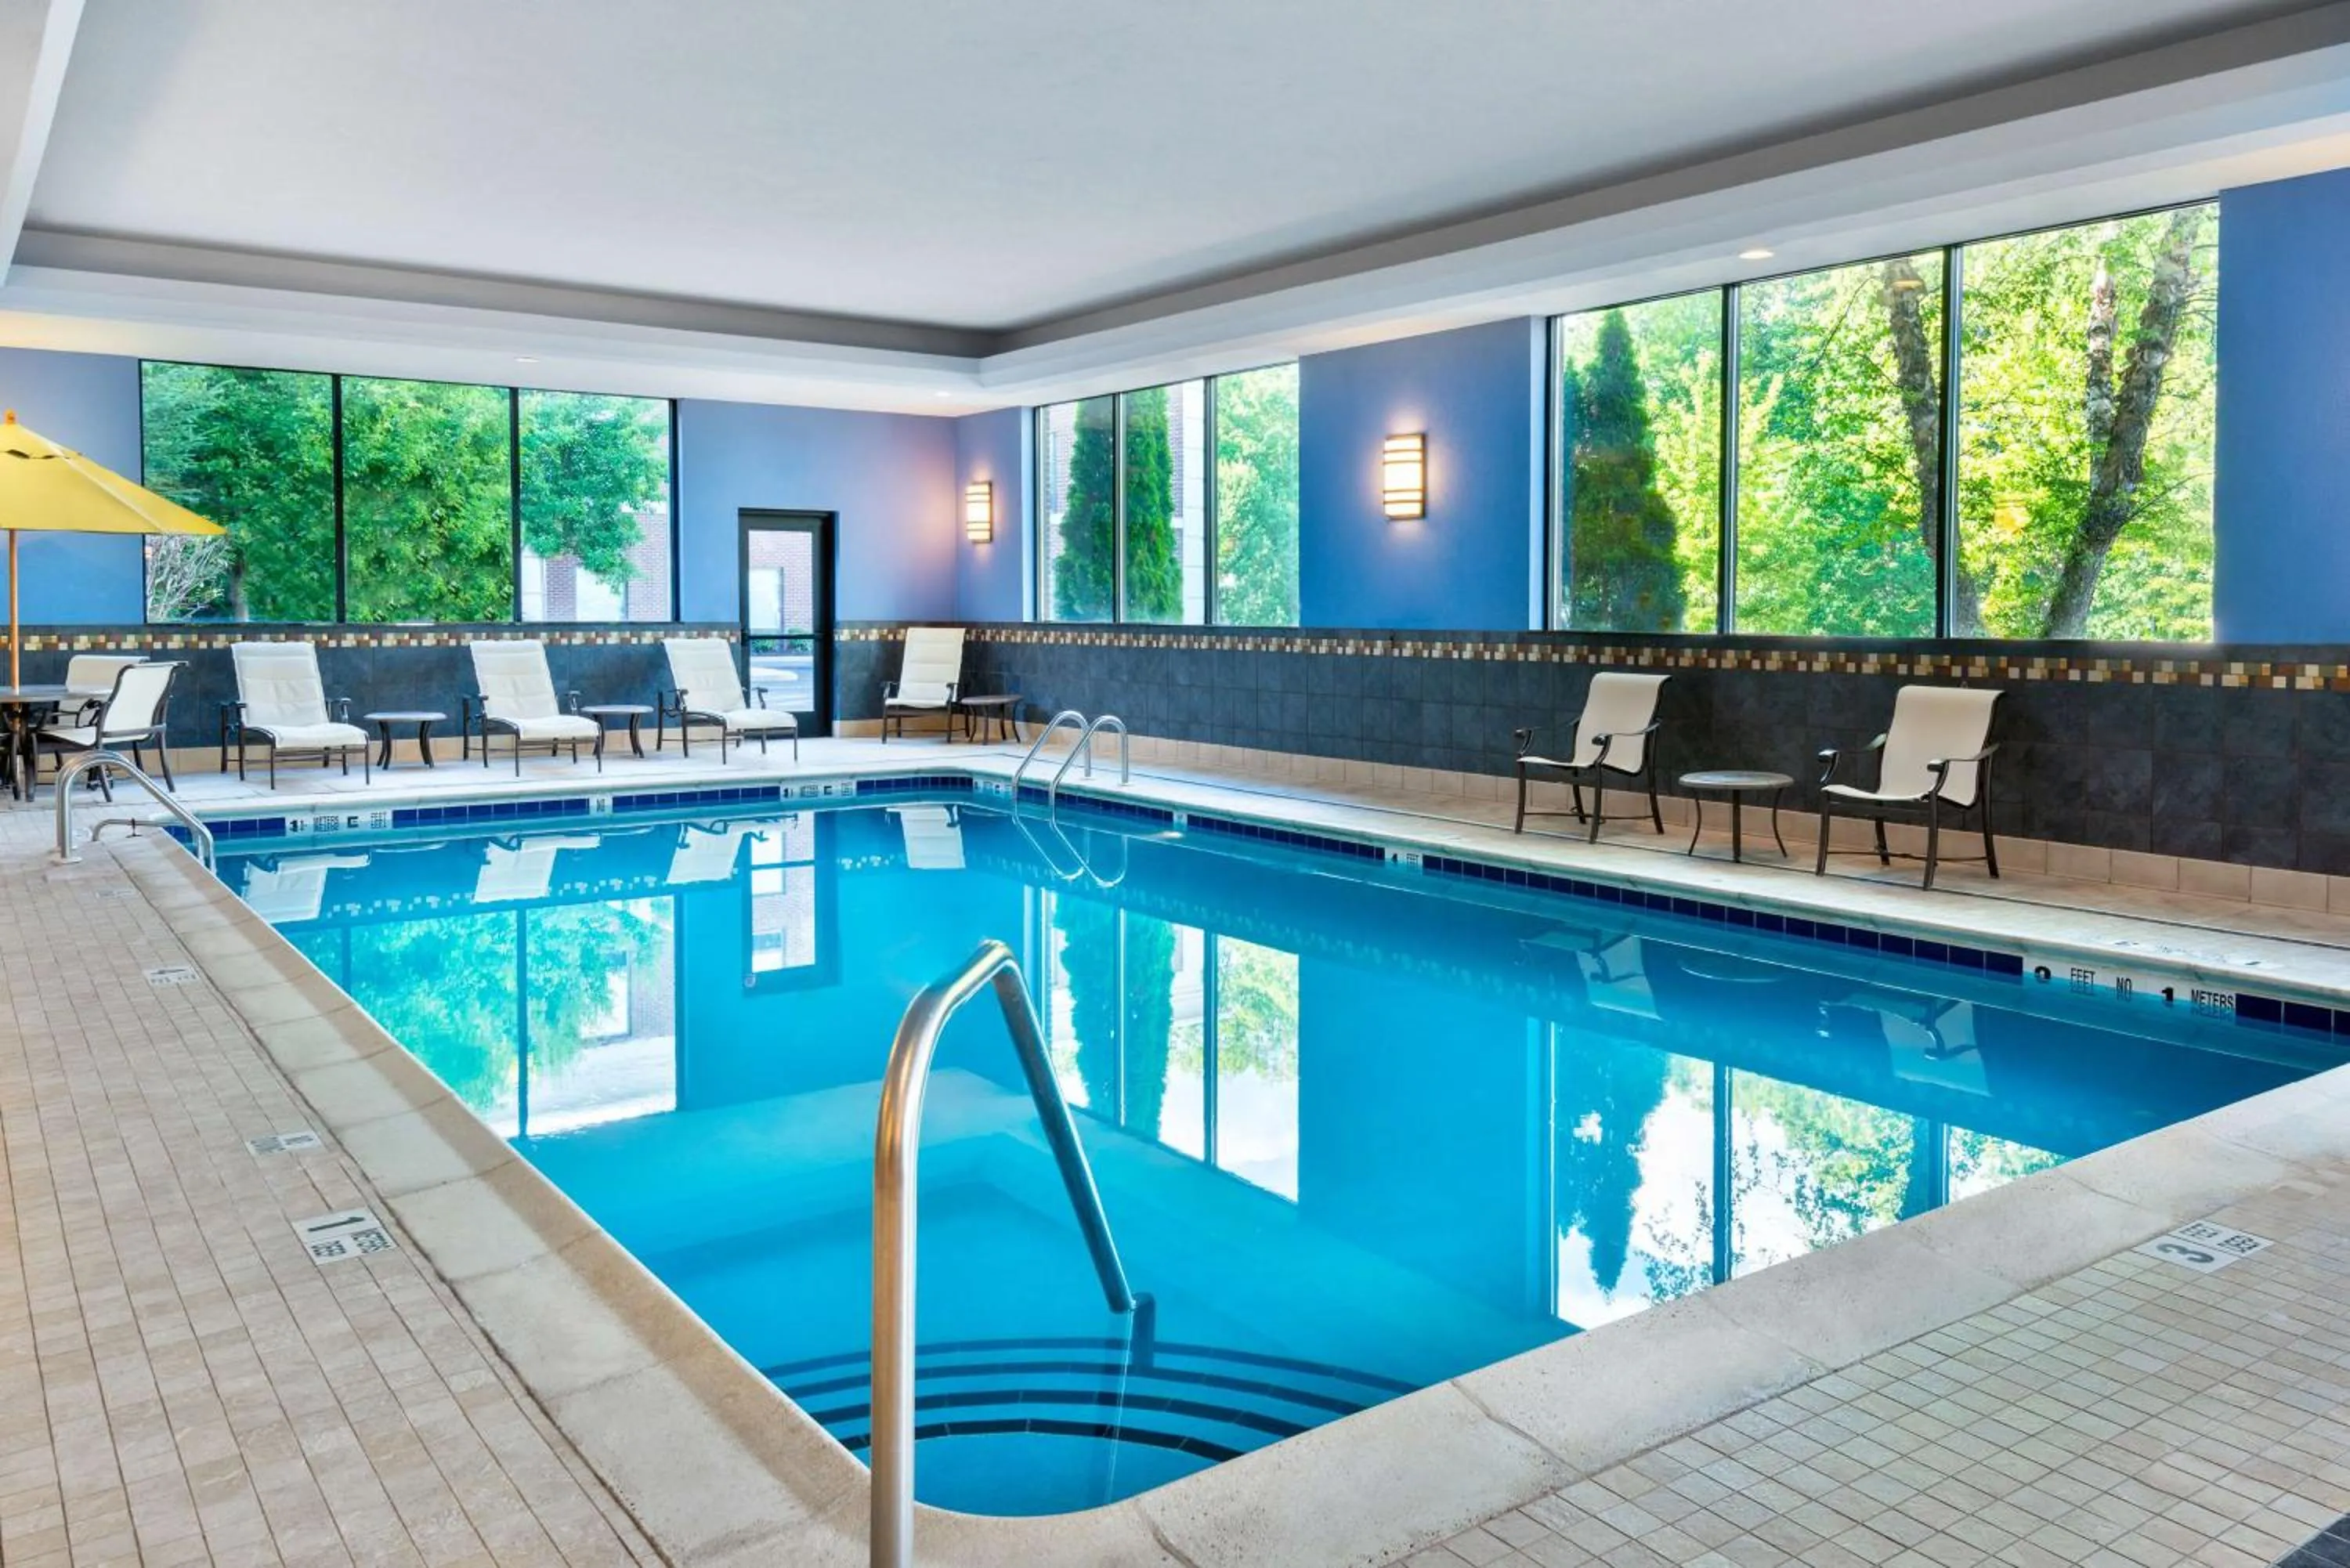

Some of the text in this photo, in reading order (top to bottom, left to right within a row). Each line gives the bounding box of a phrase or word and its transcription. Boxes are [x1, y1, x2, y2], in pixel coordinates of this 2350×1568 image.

[2070, 967, 2096, 985] FEET
[2116, 977, 2132, 994] NO
[2191, 989, 2234, 1010] METERS
[2156, 1243, 2215, 1263] 3
